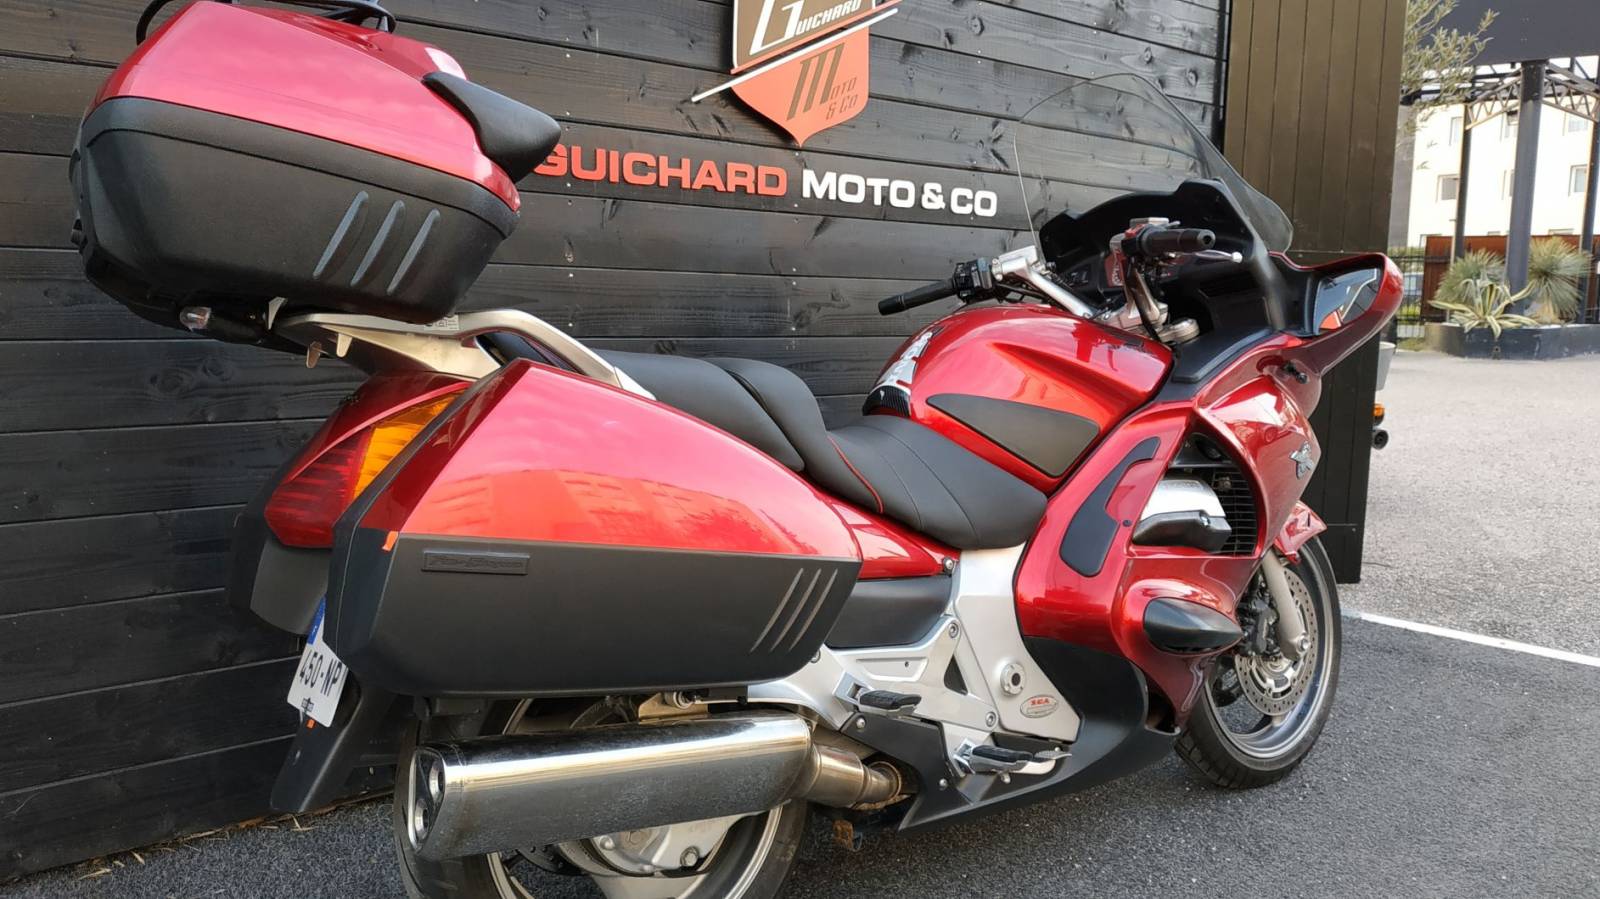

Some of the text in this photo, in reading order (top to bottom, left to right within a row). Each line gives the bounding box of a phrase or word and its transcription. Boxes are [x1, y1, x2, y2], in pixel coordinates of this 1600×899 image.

[533, 143, 998, 217] GUICHARD MOTO & CO
